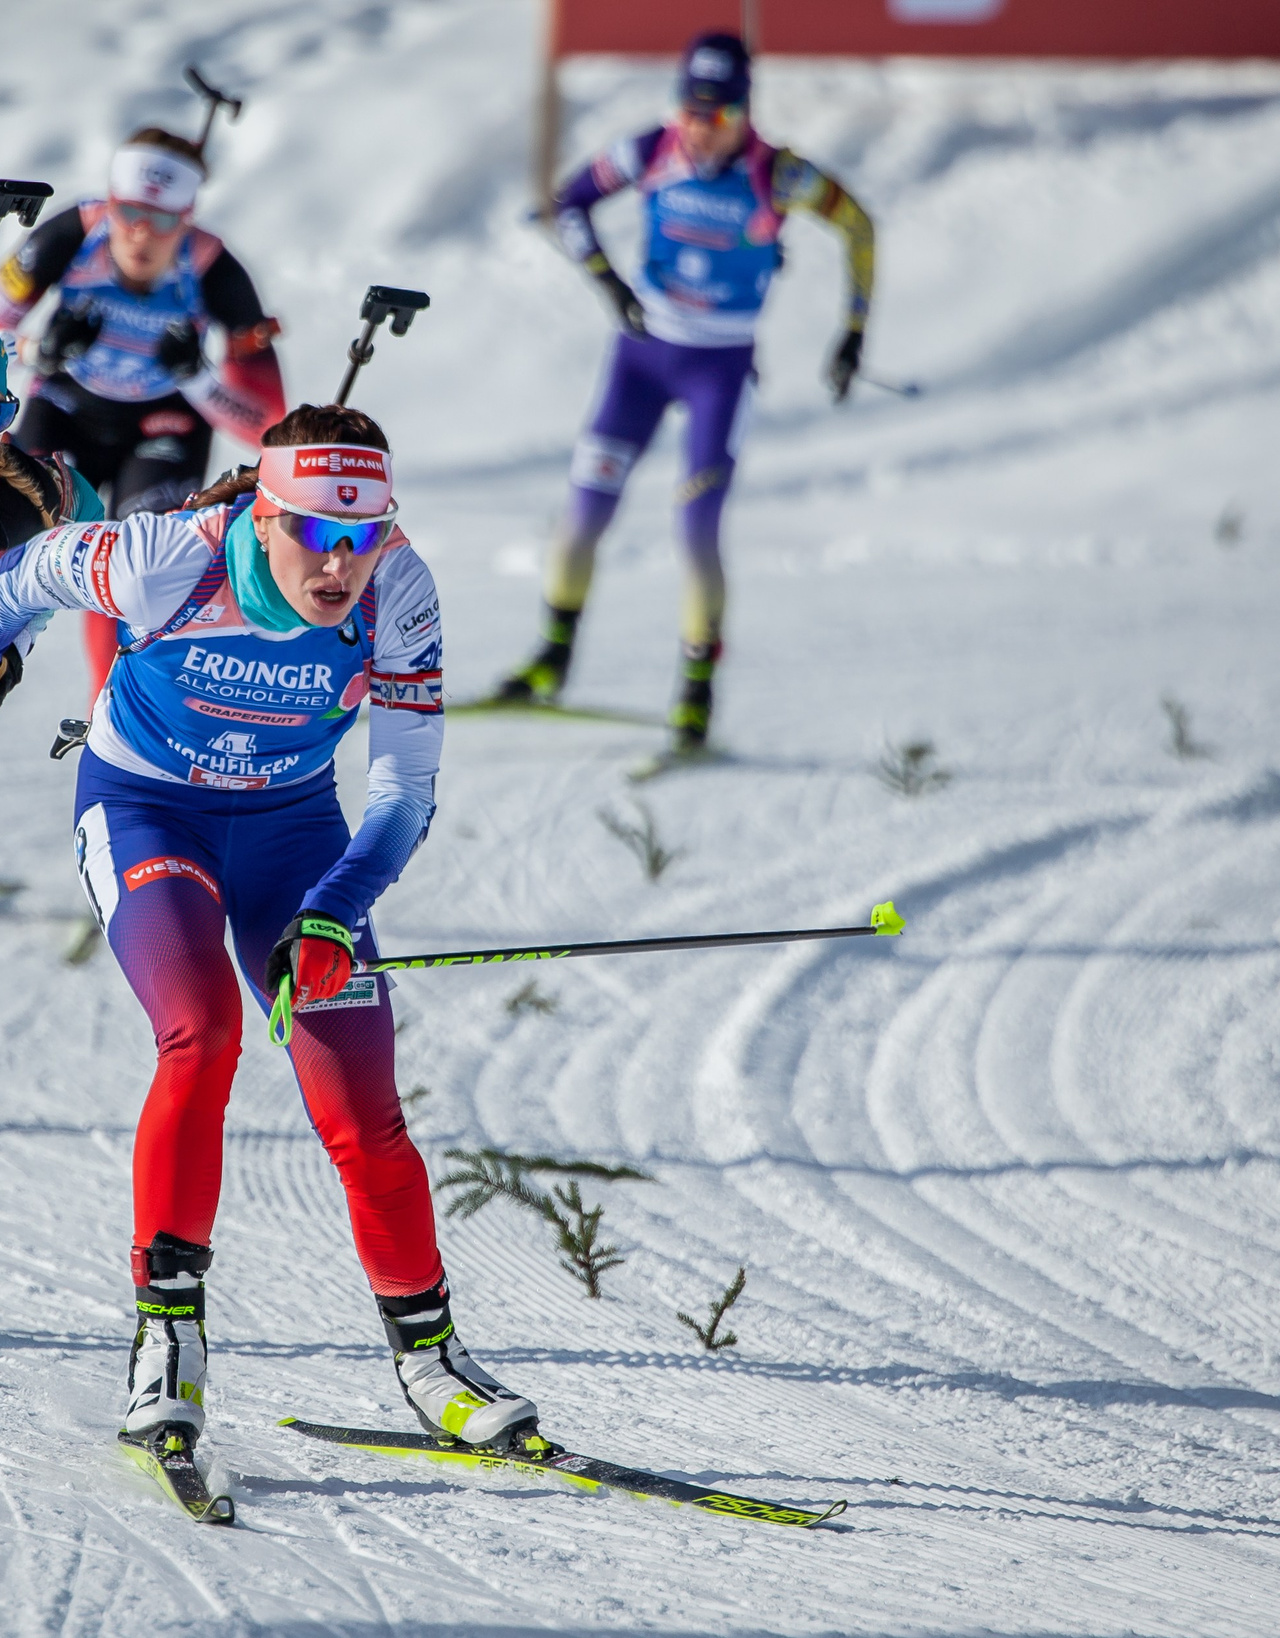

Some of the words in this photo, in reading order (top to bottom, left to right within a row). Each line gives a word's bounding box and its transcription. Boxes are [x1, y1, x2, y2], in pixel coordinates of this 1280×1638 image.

[298, 451, 384, 473] VIESSMANN
[72, 546, 97, 607] TIPO
[181, 645, 335, 693] ERDINGER
[174, 673, 330, 707] ALKOHOLFREI
[198, 704, 297, 725] GRAPEFRUIT
[129, 859, 218, 894] VIESSMANN
[692, 1494, 820, 1524] FISCHER
